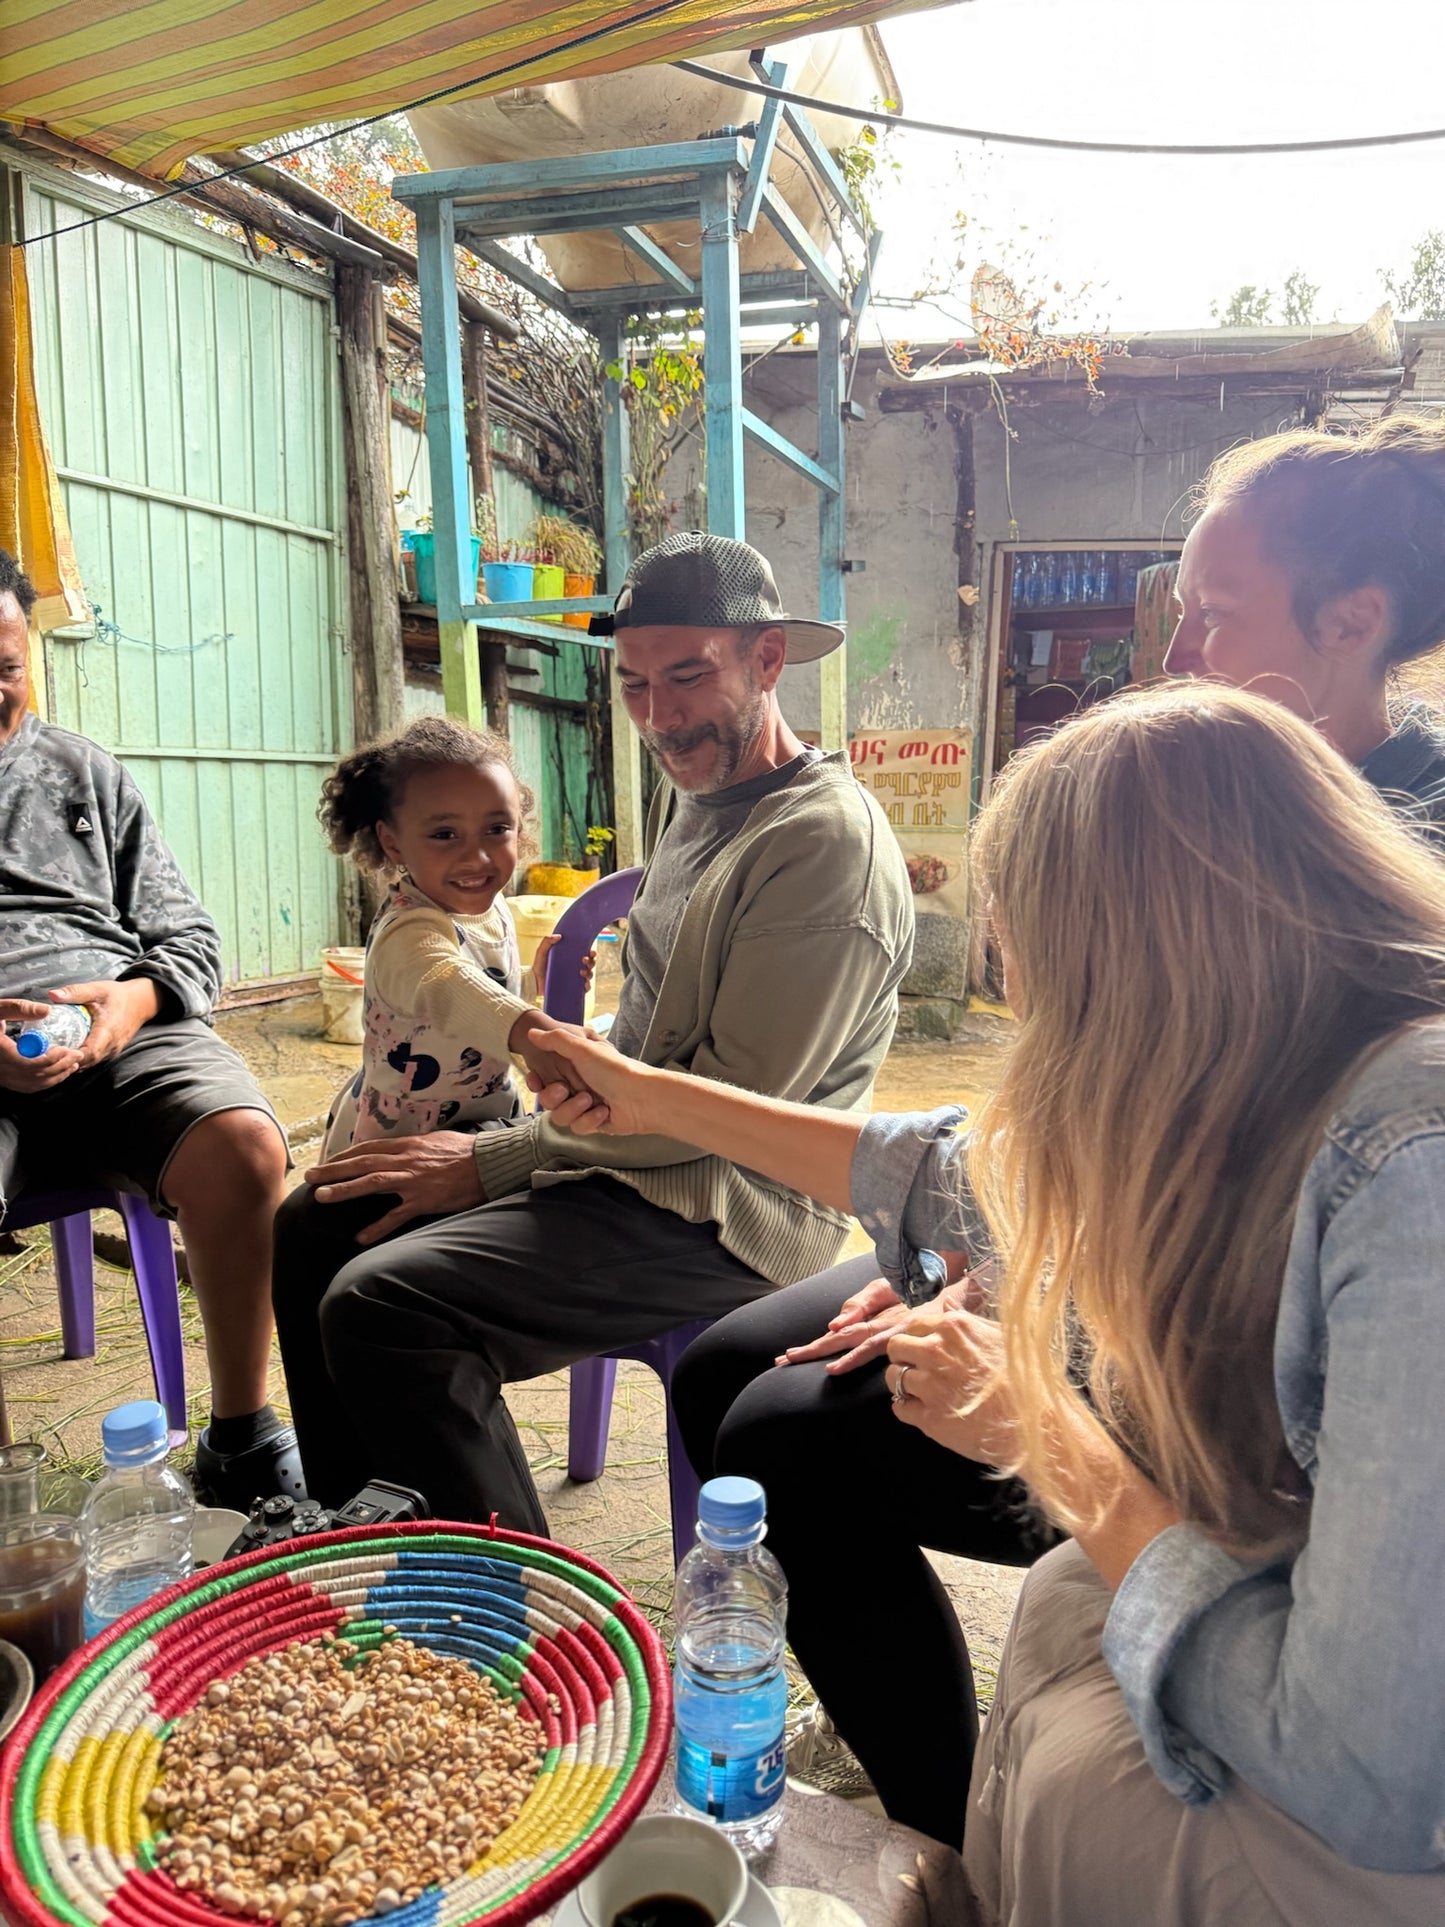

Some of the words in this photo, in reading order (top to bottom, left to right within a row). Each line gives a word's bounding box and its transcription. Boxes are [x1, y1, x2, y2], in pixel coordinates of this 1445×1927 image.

[898, 741, 966, 765] መጡ
[873, 772, 961, 799] ማርያም
[912, 801, 946, 825] ቤት
